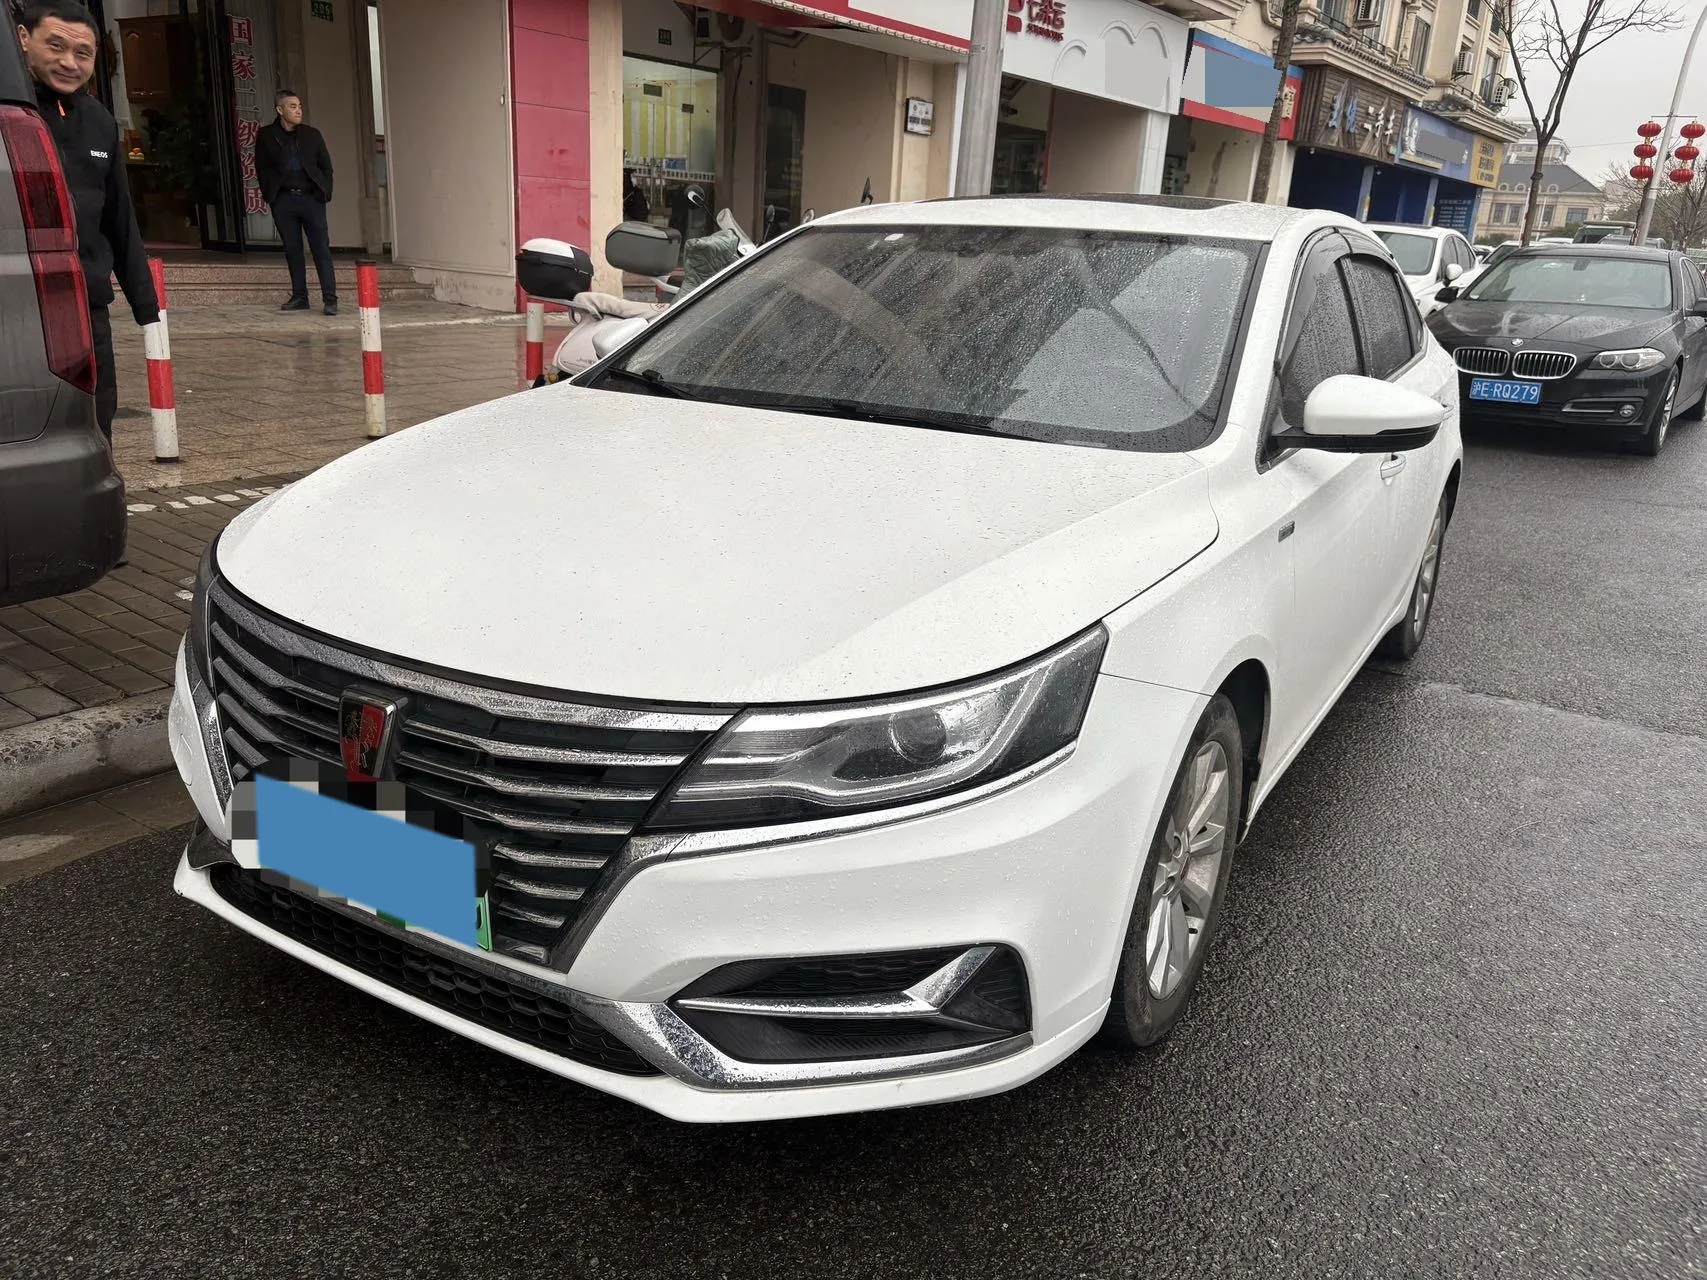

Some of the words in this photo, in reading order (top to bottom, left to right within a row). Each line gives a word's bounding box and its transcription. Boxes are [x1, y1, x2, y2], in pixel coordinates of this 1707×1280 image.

[227, 14, 269, 214] 国家二级资质
